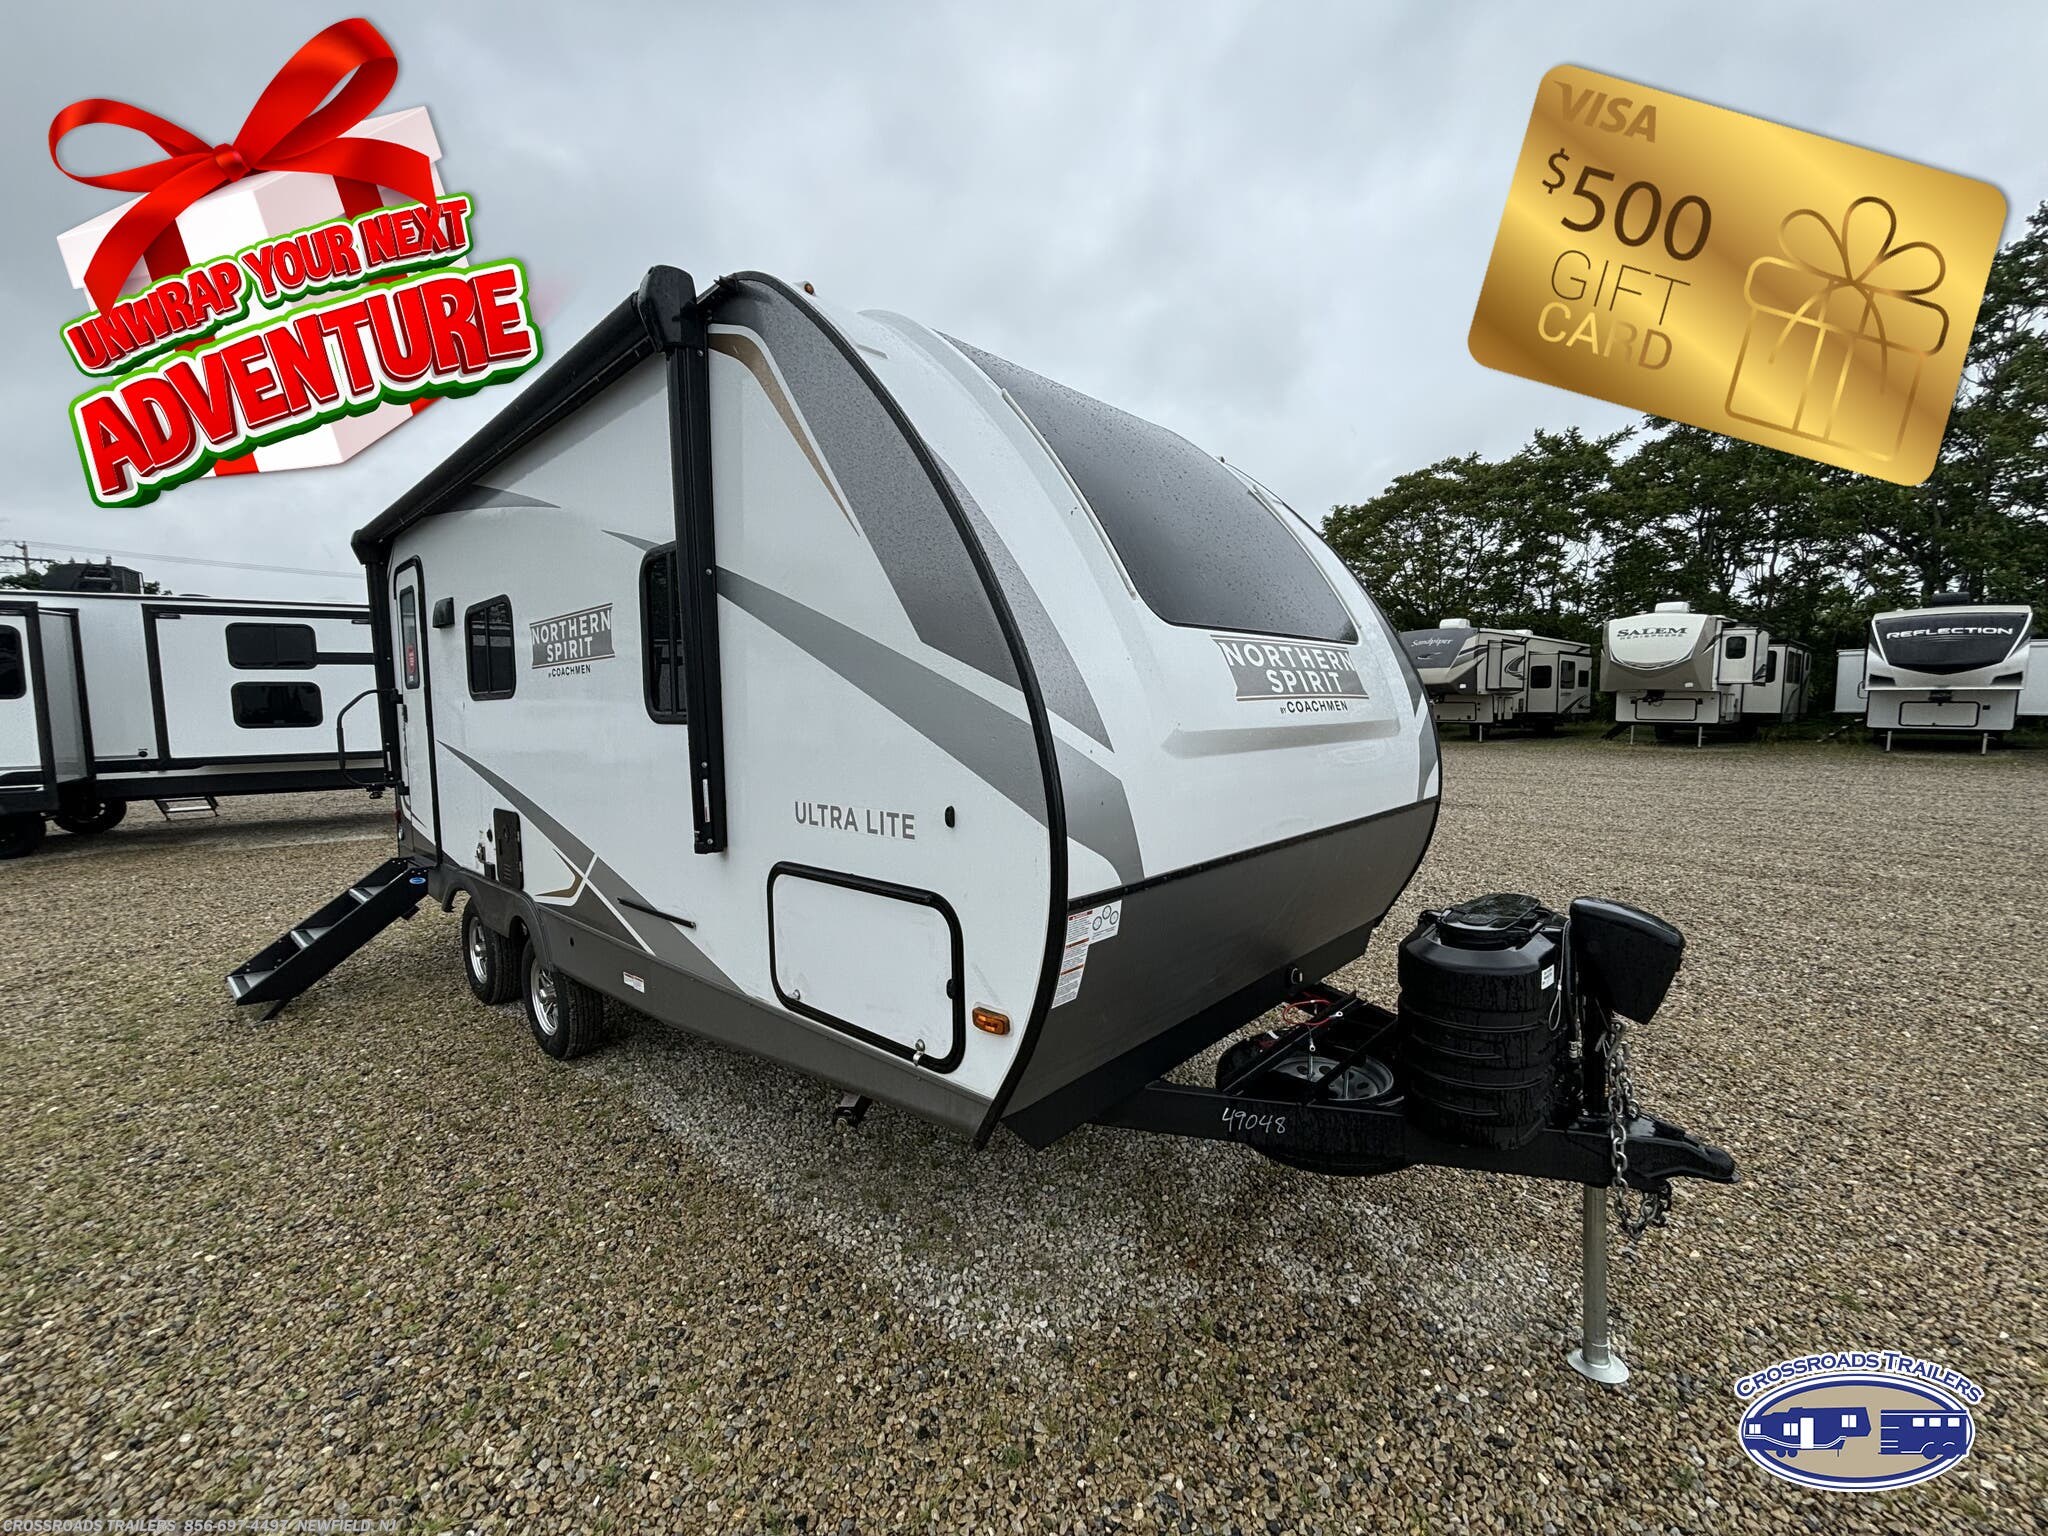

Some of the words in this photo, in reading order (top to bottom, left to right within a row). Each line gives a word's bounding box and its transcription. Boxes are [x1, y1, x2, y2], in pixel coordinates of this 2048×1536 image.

[531, 609, 611, 646] NORTHERN
[1617, 627, 1688, 637] SALEM
[1886, 627, 2013, 640] REFLECTION
[546, 636, 593, 662] SPIRIT
[1411, 637, 1453, 647] Sandpiper
[1218, 642, 1357, 672] NORTHERN
[551, 664, 592, 678] COACHMEN
[1266, 669, 1342, 693] SPIRIT
[1286, 700, 1348, 713] COACHMEN
[795, 801, 858, 832] ULTRA
[866, 809, 916, 840] LITE
[1222, 1107, 1286, 1134] 49048
